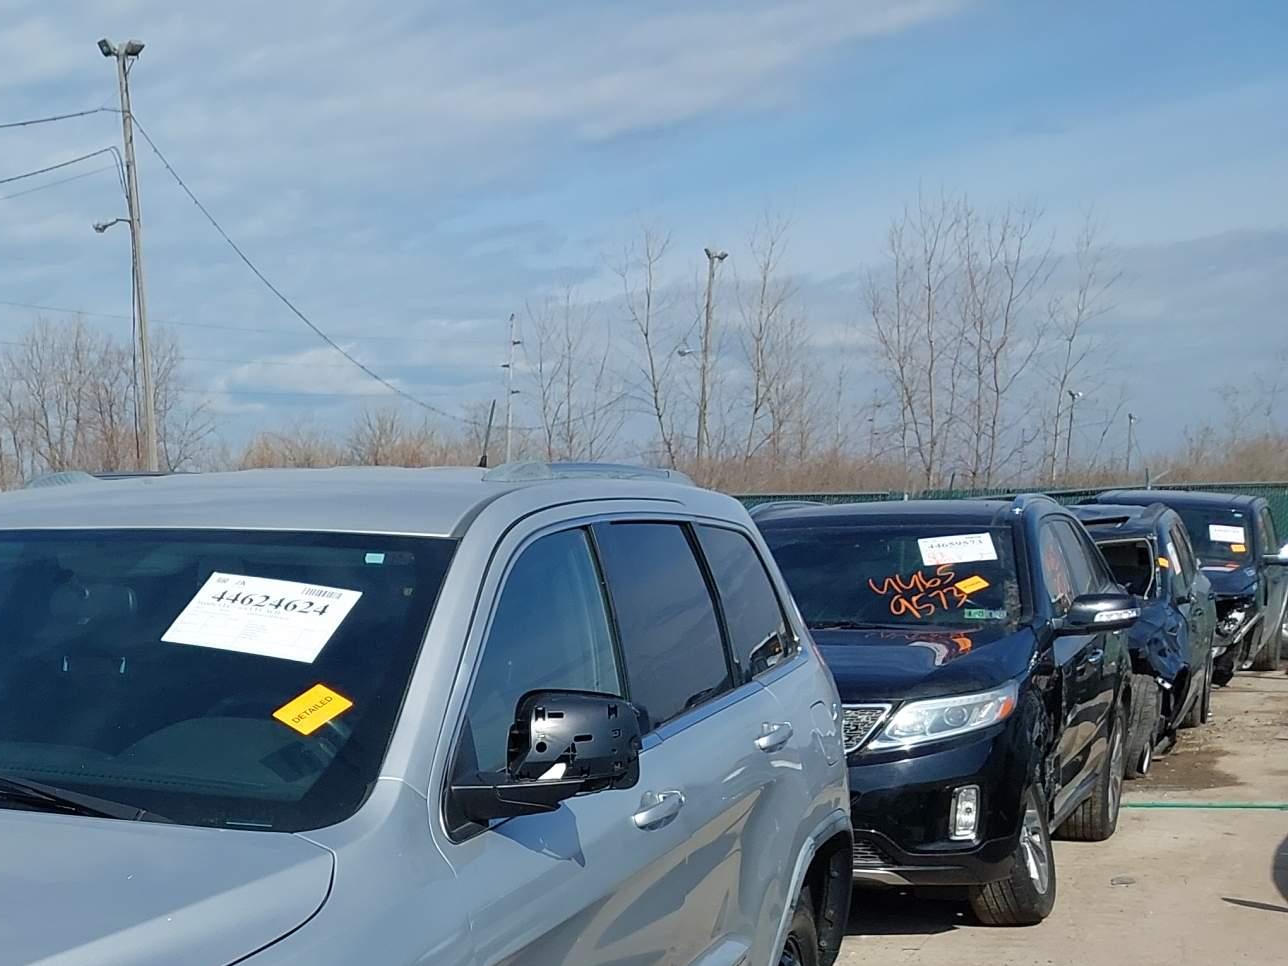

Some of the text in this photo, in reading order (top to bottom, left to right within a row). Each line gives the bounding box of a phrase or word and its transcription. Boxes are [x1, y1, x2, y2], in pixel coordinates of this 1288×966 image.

[211, 590, 330, 617] 44624624
[890, 586, 968, 619] 9573
[291, 695, 334, 725] DETAILED
